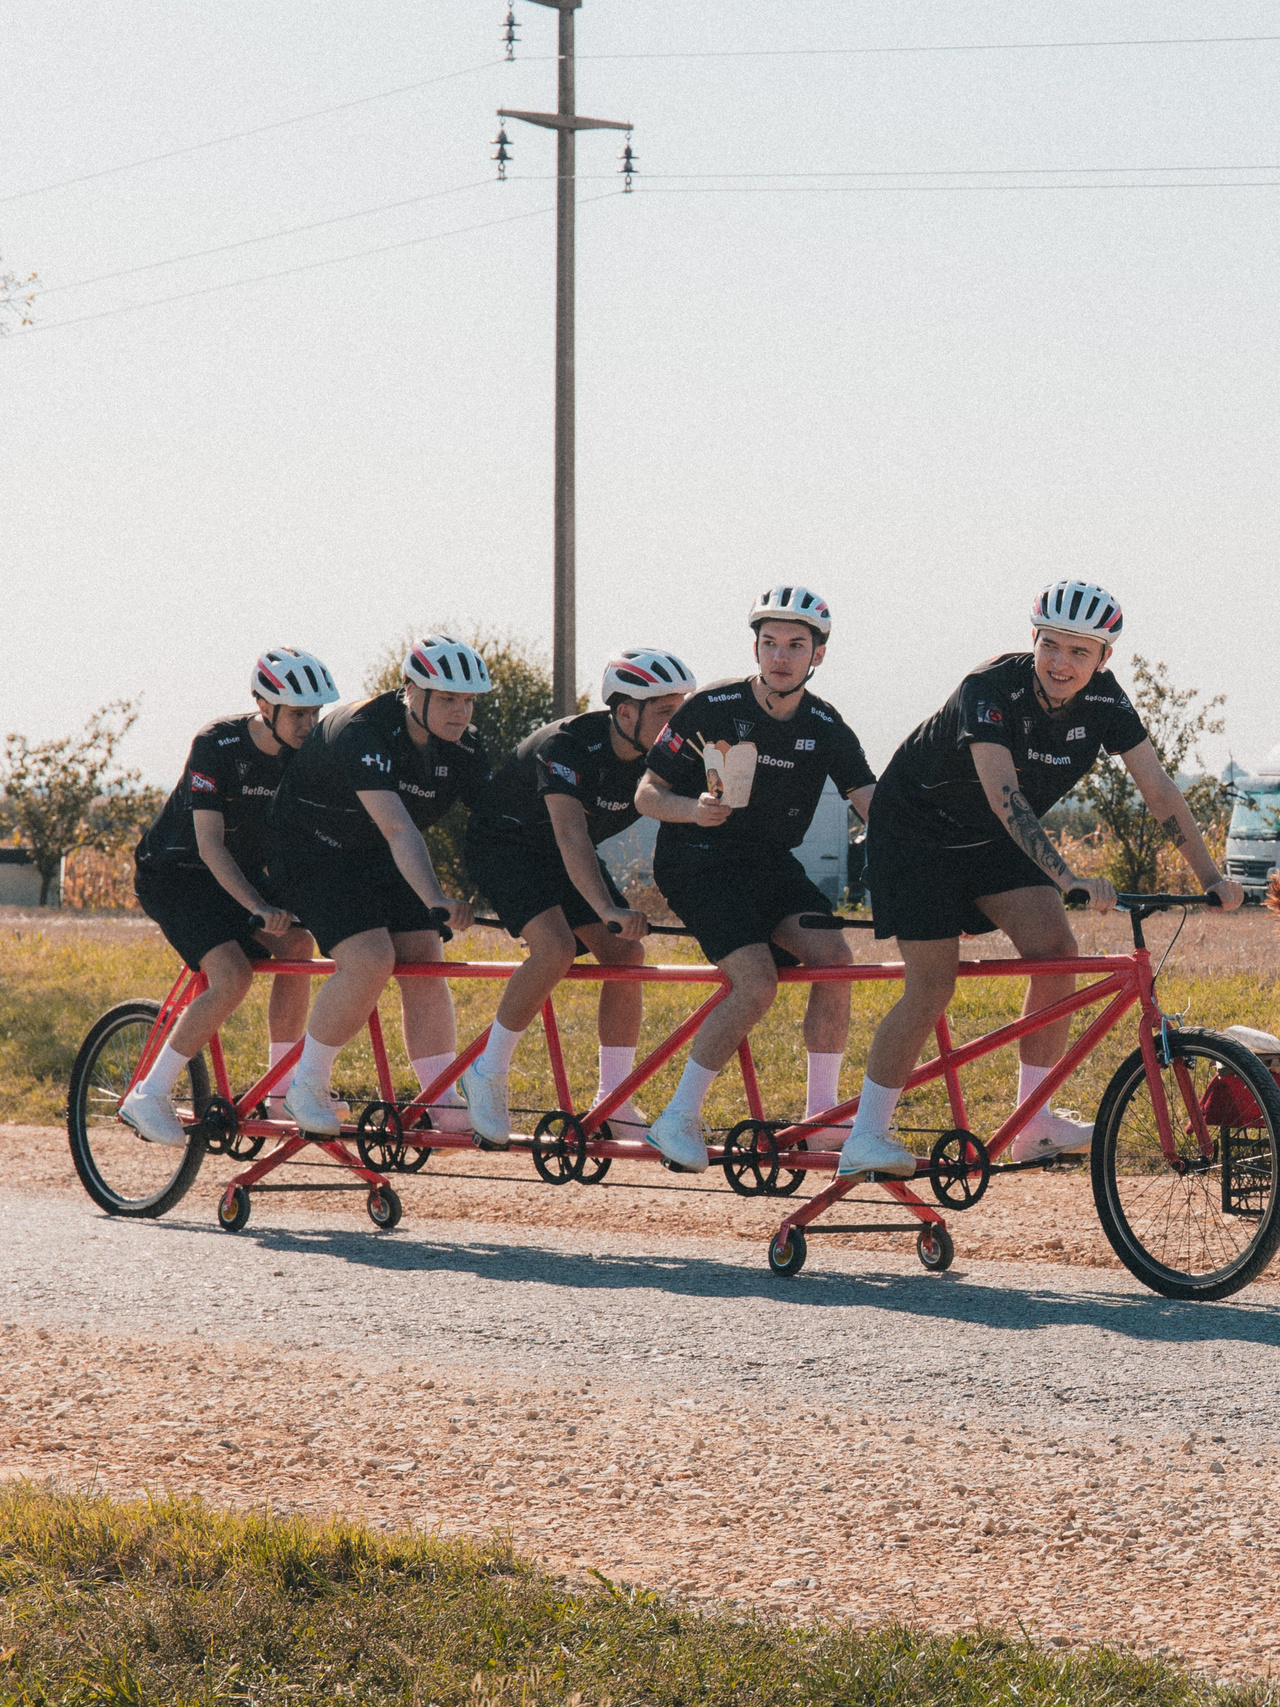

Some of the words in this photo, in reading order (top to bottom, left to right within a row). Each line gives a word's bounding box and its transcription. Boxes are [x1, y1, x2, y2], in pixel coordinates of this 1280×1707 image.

[707, 692, 742, 703] BetBoom
[1065, 726, 1087, 742] BB
[794, 738, 816, 751] BB
[757, 754, 795, 769] tBoom
[1027, 748, 1071, 766] BetBoom
[242, 785, 276, 797] BetBoo
